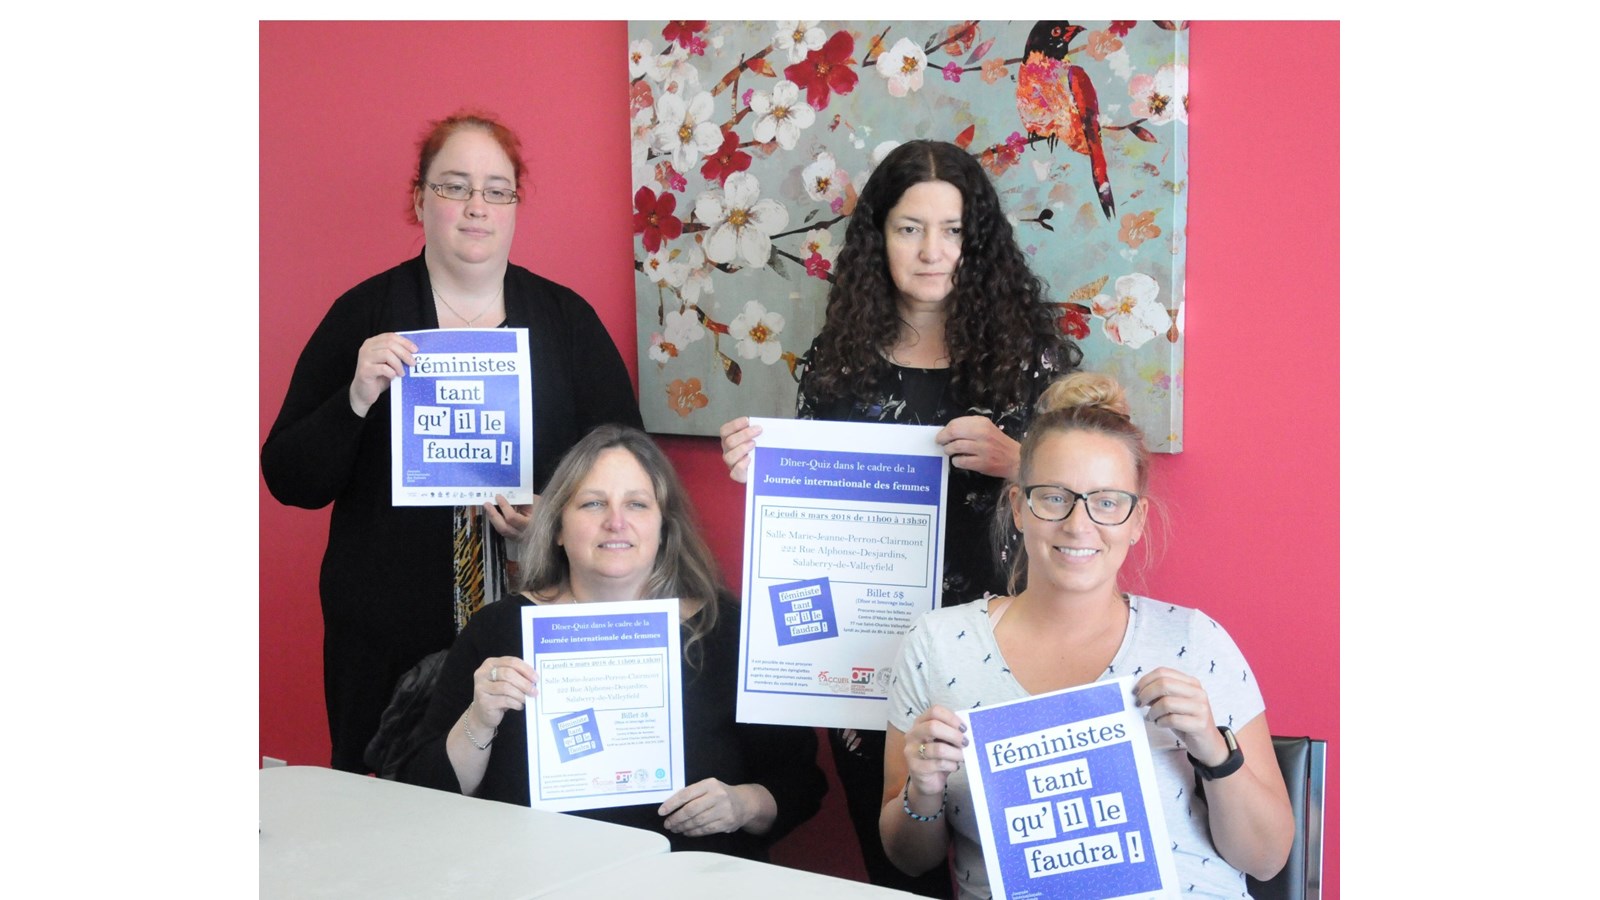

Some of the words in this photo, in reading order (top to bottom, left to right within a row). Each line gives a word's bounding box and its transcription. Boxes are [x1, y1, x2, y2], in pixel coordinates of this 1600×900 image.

[413, 357, 516, 373] féministes
[440, 387, 481, 400] tant
[458, 413, 470, 429] il
[484, 414, 501, 430] le
[427, 442, 492, 459] faudra
[504, 445, 508, 461] !
[780, 458, 831, 470] Dîner-Quiz
[834, 461, 854, 470] dans
[857, 462, 865, 471] le
[867, 463, 892, 472] cadre
[894, 464, 905, 472] de
[907, 465, 915, 473] la
[764, 475, 801, 485] Journée
[804, 476, 871, 488] internationale
[874, 480, 890, 490] des
[893, 482, 930, 492] femmes
[764, 510, 774, 518] Le
[777, 510, 798, 519] jeudi
[867, 514, 891, 522] 11h00
[902, 516, 927, 524] 13h30
[789, 531, 923, 546] Marie-Jeanne-Perron-Clairmont
[818, 547, 907, 560] Alphonse-Desjardins,
[793, 559, 894, 572] Salaberry-de-Valleyfield
[780, 587, 820, 601] féministe
[867, 589, 890, 598] Billet
[893, 590, 904, 599] 5$
[793, 601, 810, 609] tant
[813, 611, 822, 619] le
[552, 622, 589, 631] Dîner-Quiz
[792, 624, 819, 635] faudra
[992, 722, 1126, 767] féministes
[1032, 768, 1087, 793] tant
[1064, 803, 1082, 826] il
[1098, 801, 1121, 822] le
[1032, 843, 1117, 872] faudra
[1131, 836, 1139, 857] !
